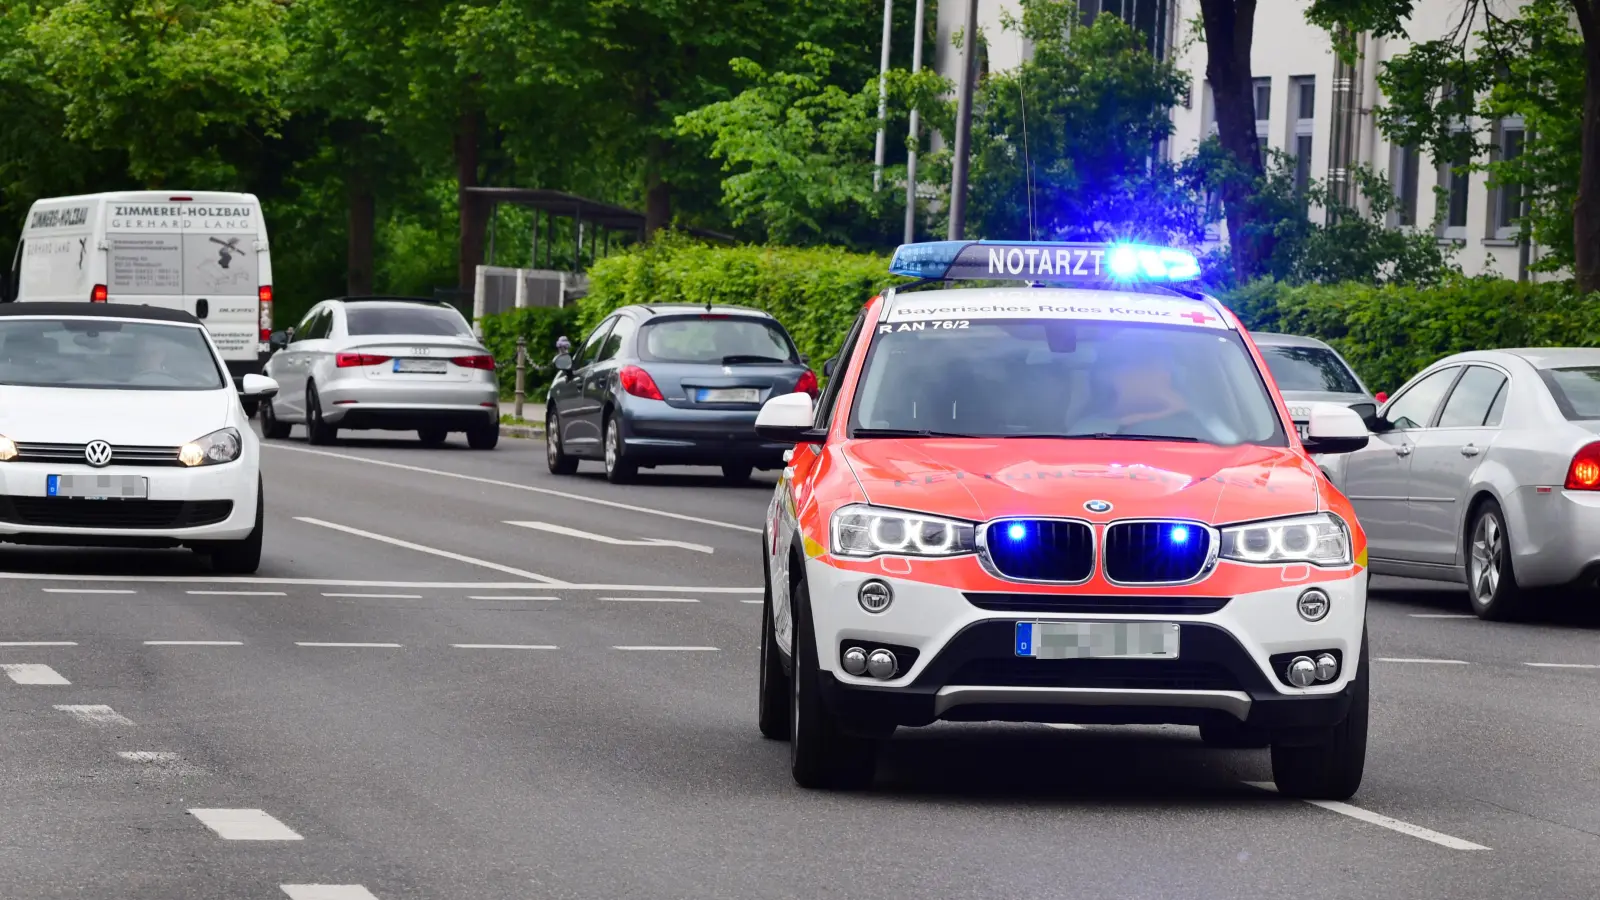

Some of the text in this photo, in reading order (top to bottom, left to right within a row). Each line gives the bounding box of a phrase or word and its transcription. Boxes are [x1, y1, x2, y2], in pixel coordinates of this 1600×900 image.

[115, 206, 251, 217] ZIMMEREI-HOLZBAU
[112, 219, 249, 228] GERHARD LANG
[988, 248, 1105, 276] NOTARZT
[898, 305, 1171, 316] Bayerisches Rotes Kreuz
[879, 320, 970, 334] R AN 76/2
[1021, 642, 1027, 650] D
